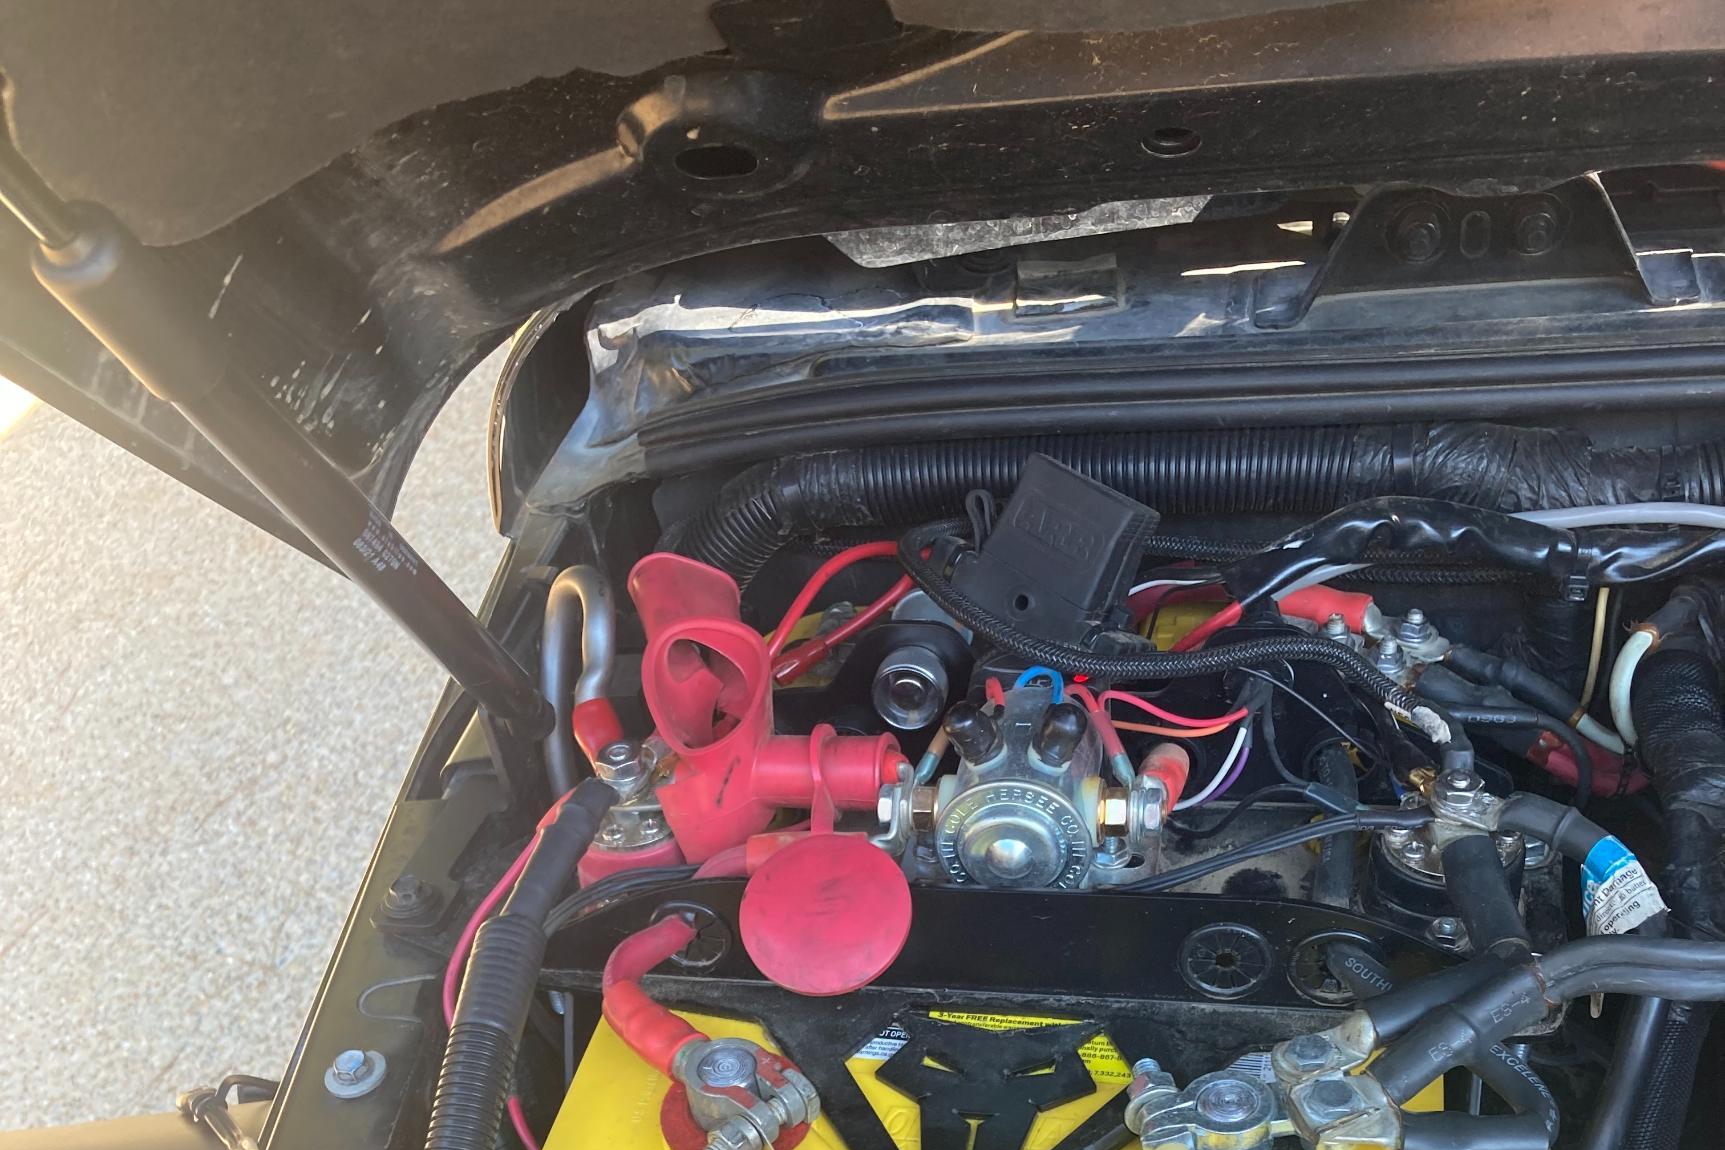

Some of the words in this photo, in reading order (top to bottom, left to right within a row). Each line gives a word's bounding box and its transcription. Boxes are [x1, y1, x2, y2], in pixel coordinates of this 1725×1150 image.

[1602, 867, 1639, 898] Damage
[965, 1014, 989, 1023] FREE
[989, 1015, 1044, 1028] Replacement
